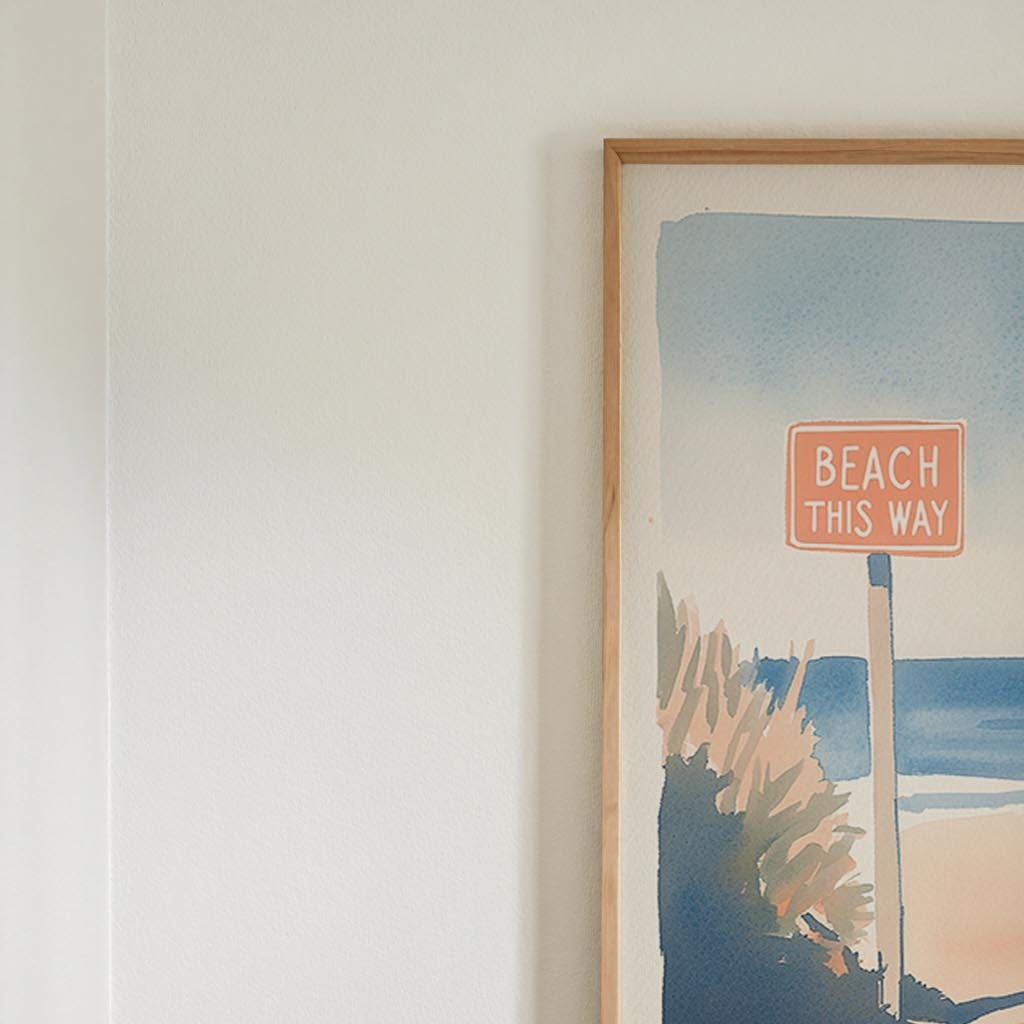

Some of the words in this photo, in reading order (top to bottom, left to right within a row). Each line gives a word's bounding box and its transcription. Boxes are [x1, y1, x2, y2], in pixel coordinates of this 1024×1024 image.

[815, 445, 938, 490] BEACH
[804, 499, 873, 537] THIS
[888, 499, 948, 536] WAY
